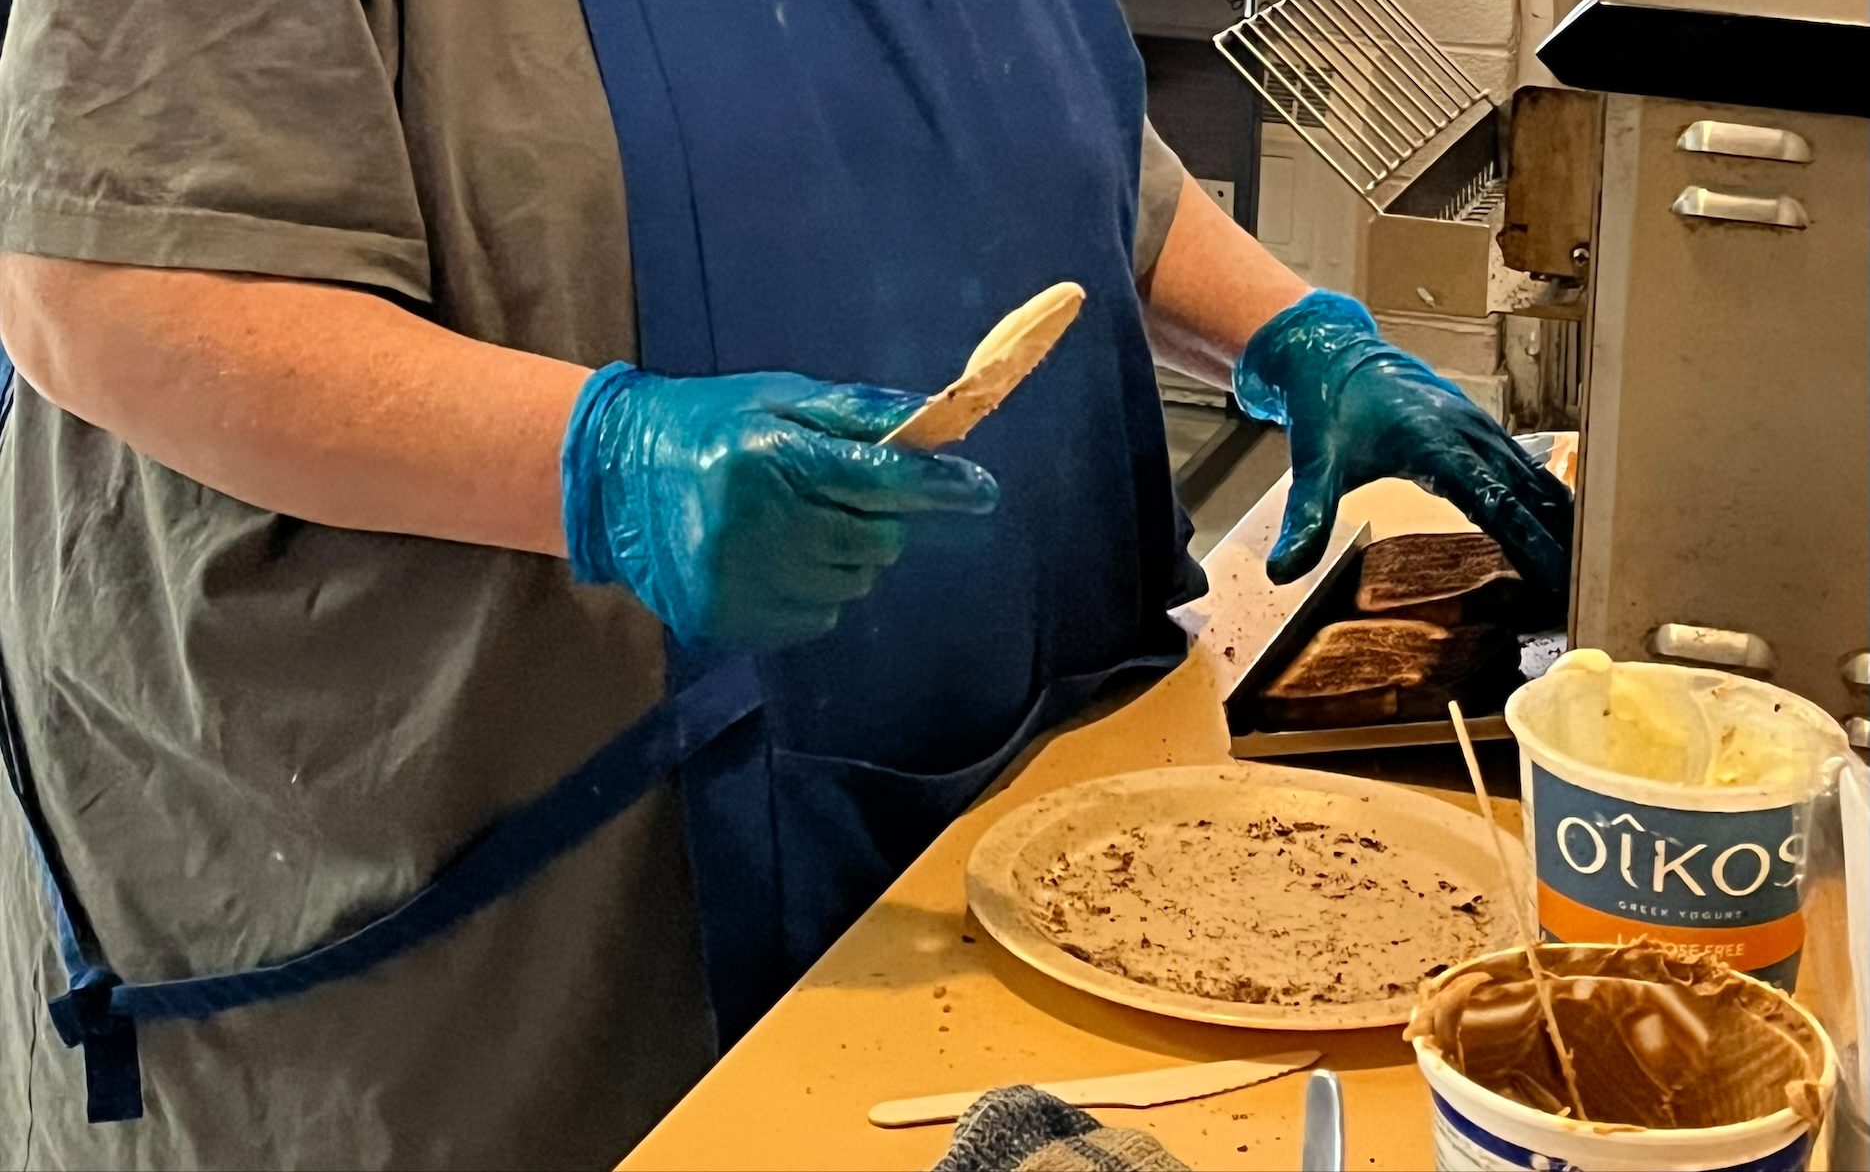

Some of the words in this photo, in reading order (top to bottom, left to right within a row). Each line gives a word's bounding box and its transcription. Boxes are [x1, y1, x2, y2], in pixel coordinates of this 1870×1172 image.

[1618, 900, 1669, 917] GREEK
[1679, 910, 1742, 920] YOGURT
[1704, 942, 1744, 959] FREE
